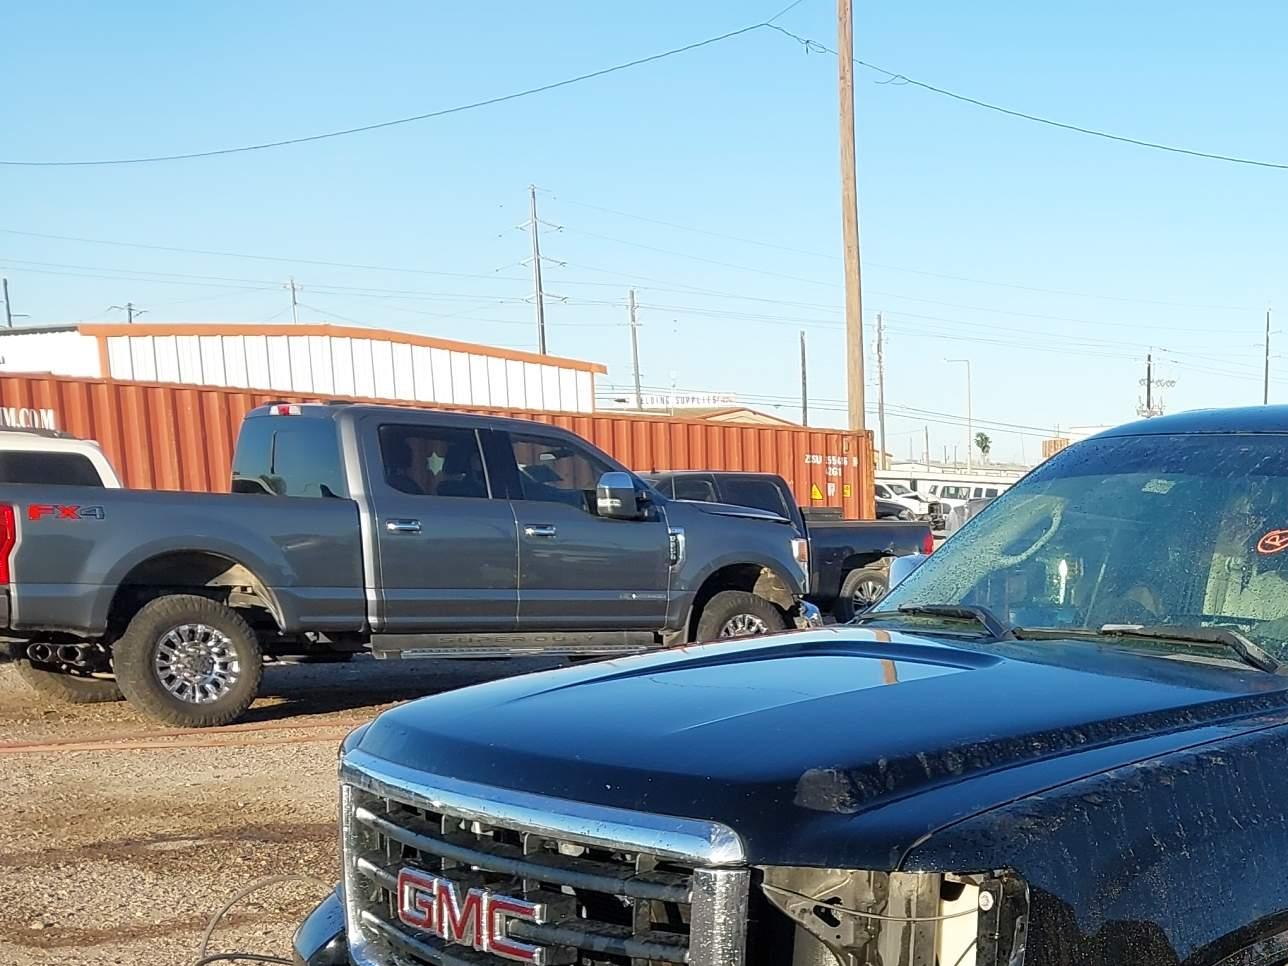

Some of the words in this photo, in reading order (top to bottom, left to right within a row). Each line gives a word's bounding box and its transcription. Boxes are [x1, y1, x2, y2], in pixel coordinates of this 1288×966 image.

[639, 394, 670, 406] ELDING
[27, 503, 105, 521] FX4
[439, 636, 525, 644] SUPER
[397, 867, 548, 966] GMC
